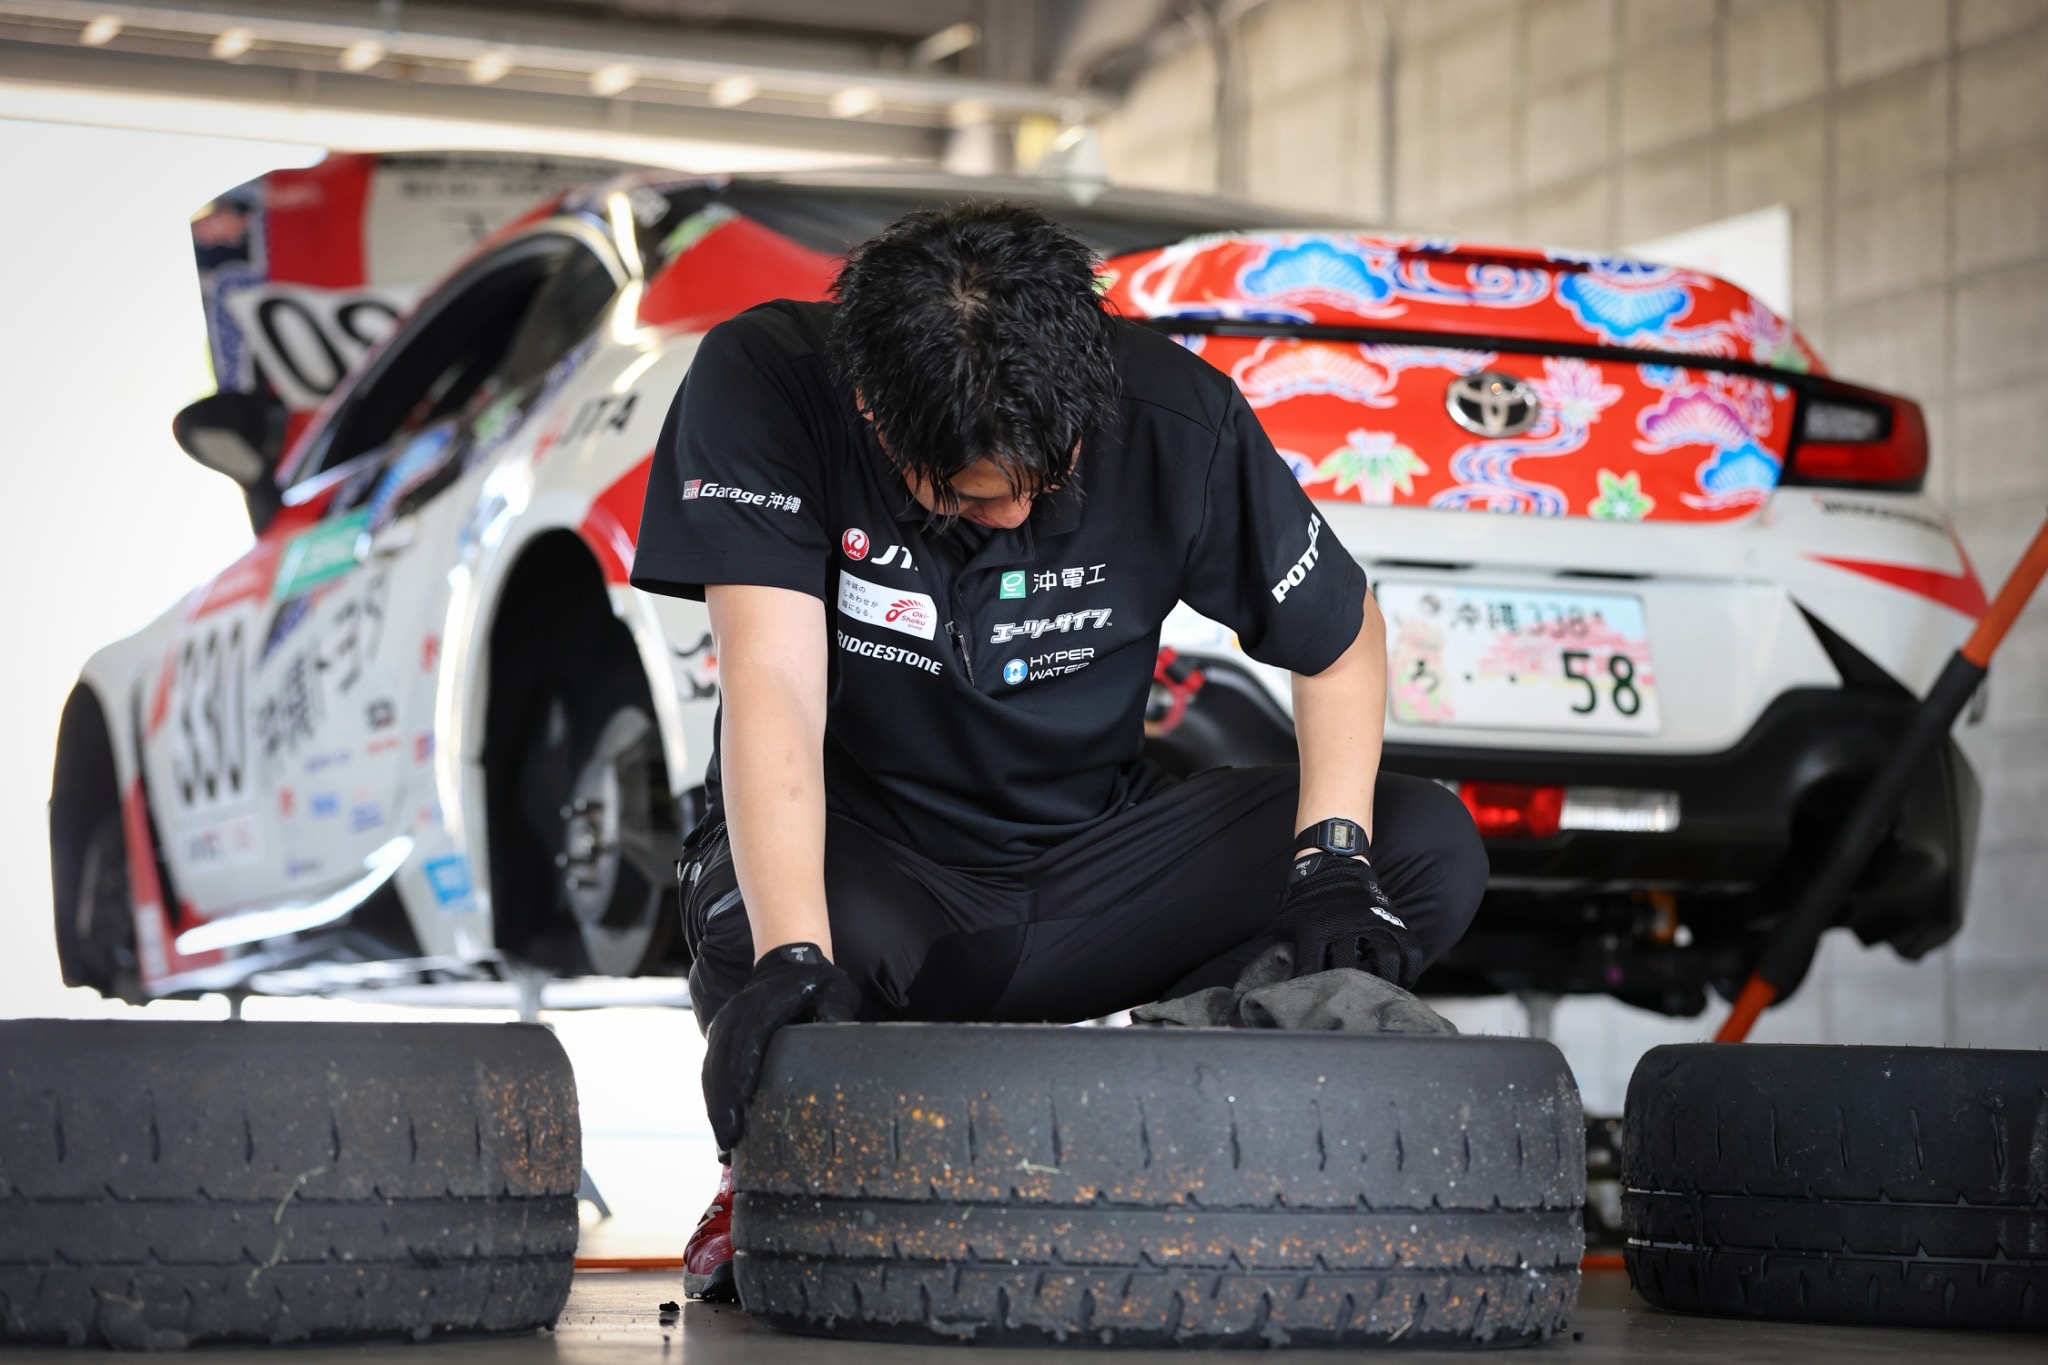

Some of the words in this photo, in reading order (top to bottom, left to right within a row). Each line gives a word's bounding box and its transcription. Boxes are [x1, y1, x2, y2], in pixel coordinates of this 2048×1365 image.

[700, 482, 766, 505] Garage
[765, 491, 802, 514] 沖縄
[1032, 563, 1106, 594] 沖電工
[901, 615, 926, 627] Shoku
[837, 628, 943, 676] RIDGESTONE
[1029, 647, 1095, 668] HYPER
